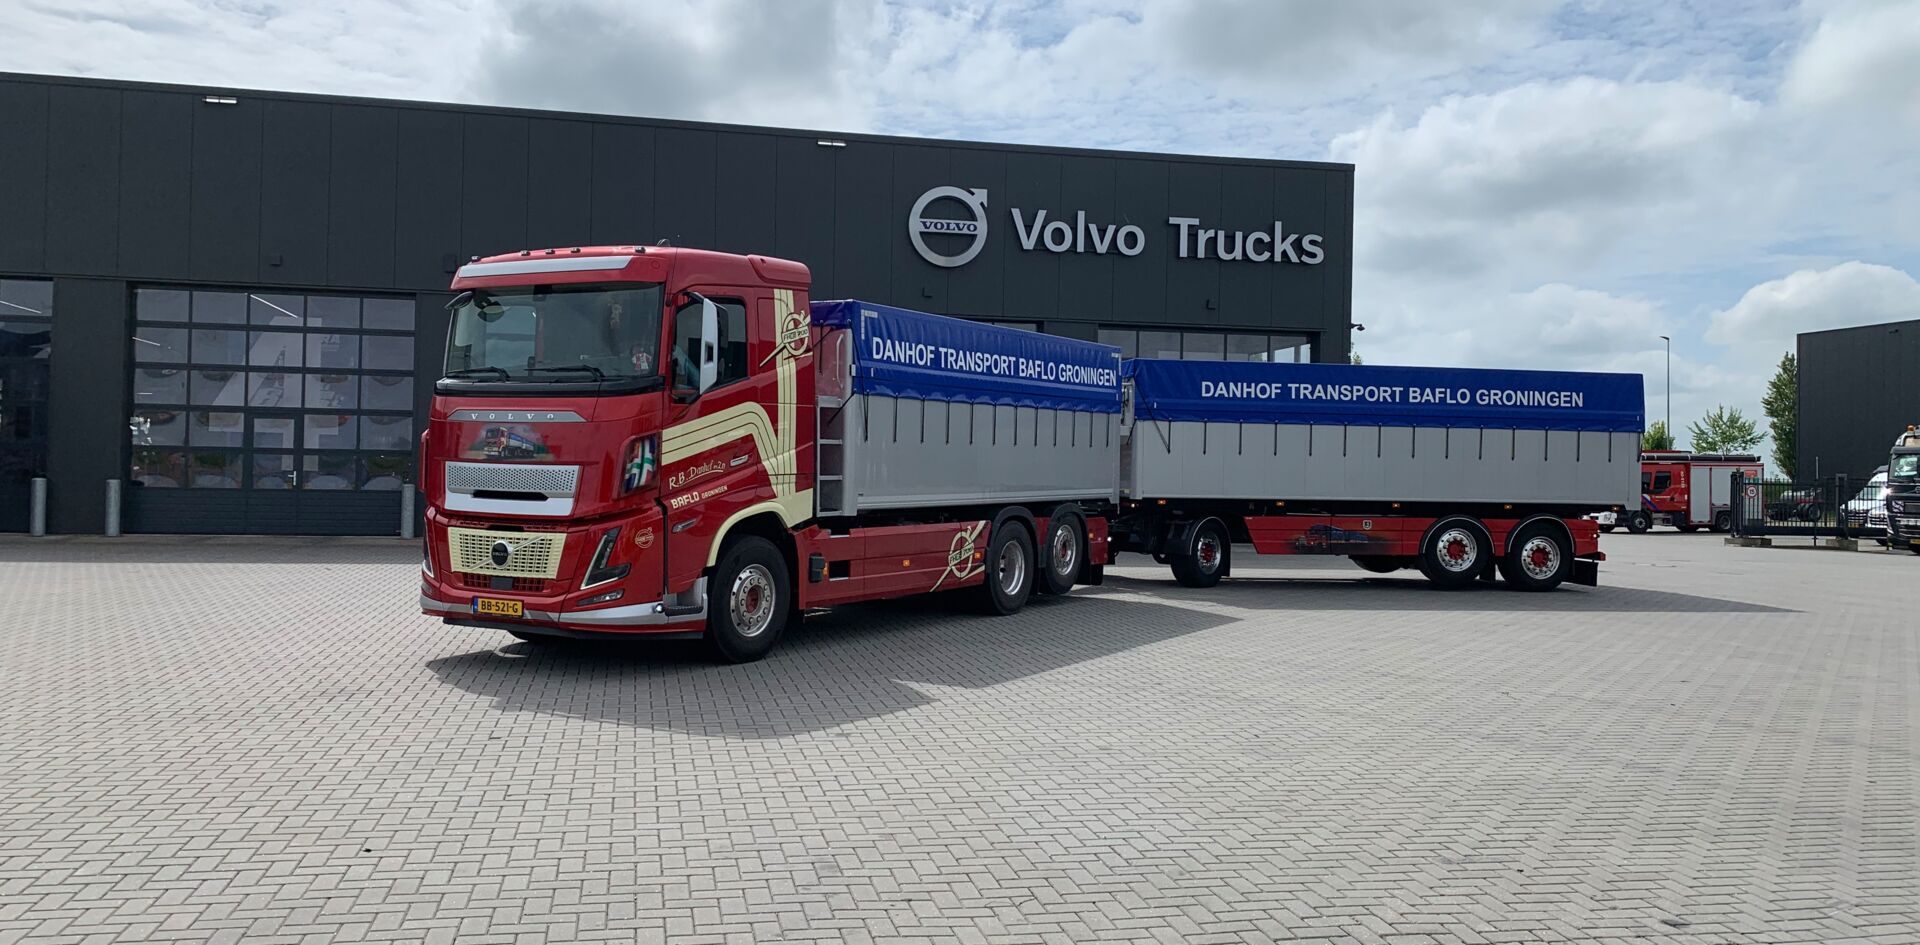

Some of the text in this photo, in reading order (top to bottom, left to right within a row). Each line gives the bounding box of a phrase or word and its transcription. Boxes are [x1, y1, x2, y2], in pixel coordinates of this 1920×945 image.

[920, 220, 978, 232] VOLVO
[1010, 207, 1325, 265] Volvo Trucks
[872, 336, 1117, 387] DANHOF TRANSPORT BAFLO GRONINGEN
[1201, 381, 1584, 408] DANHOF TRANSPORT BAFLO GRONINGEN
[670, 485, 728, 509] BAFLO GRONINGEN
[480, 600, 519, 613] BB-521-G
